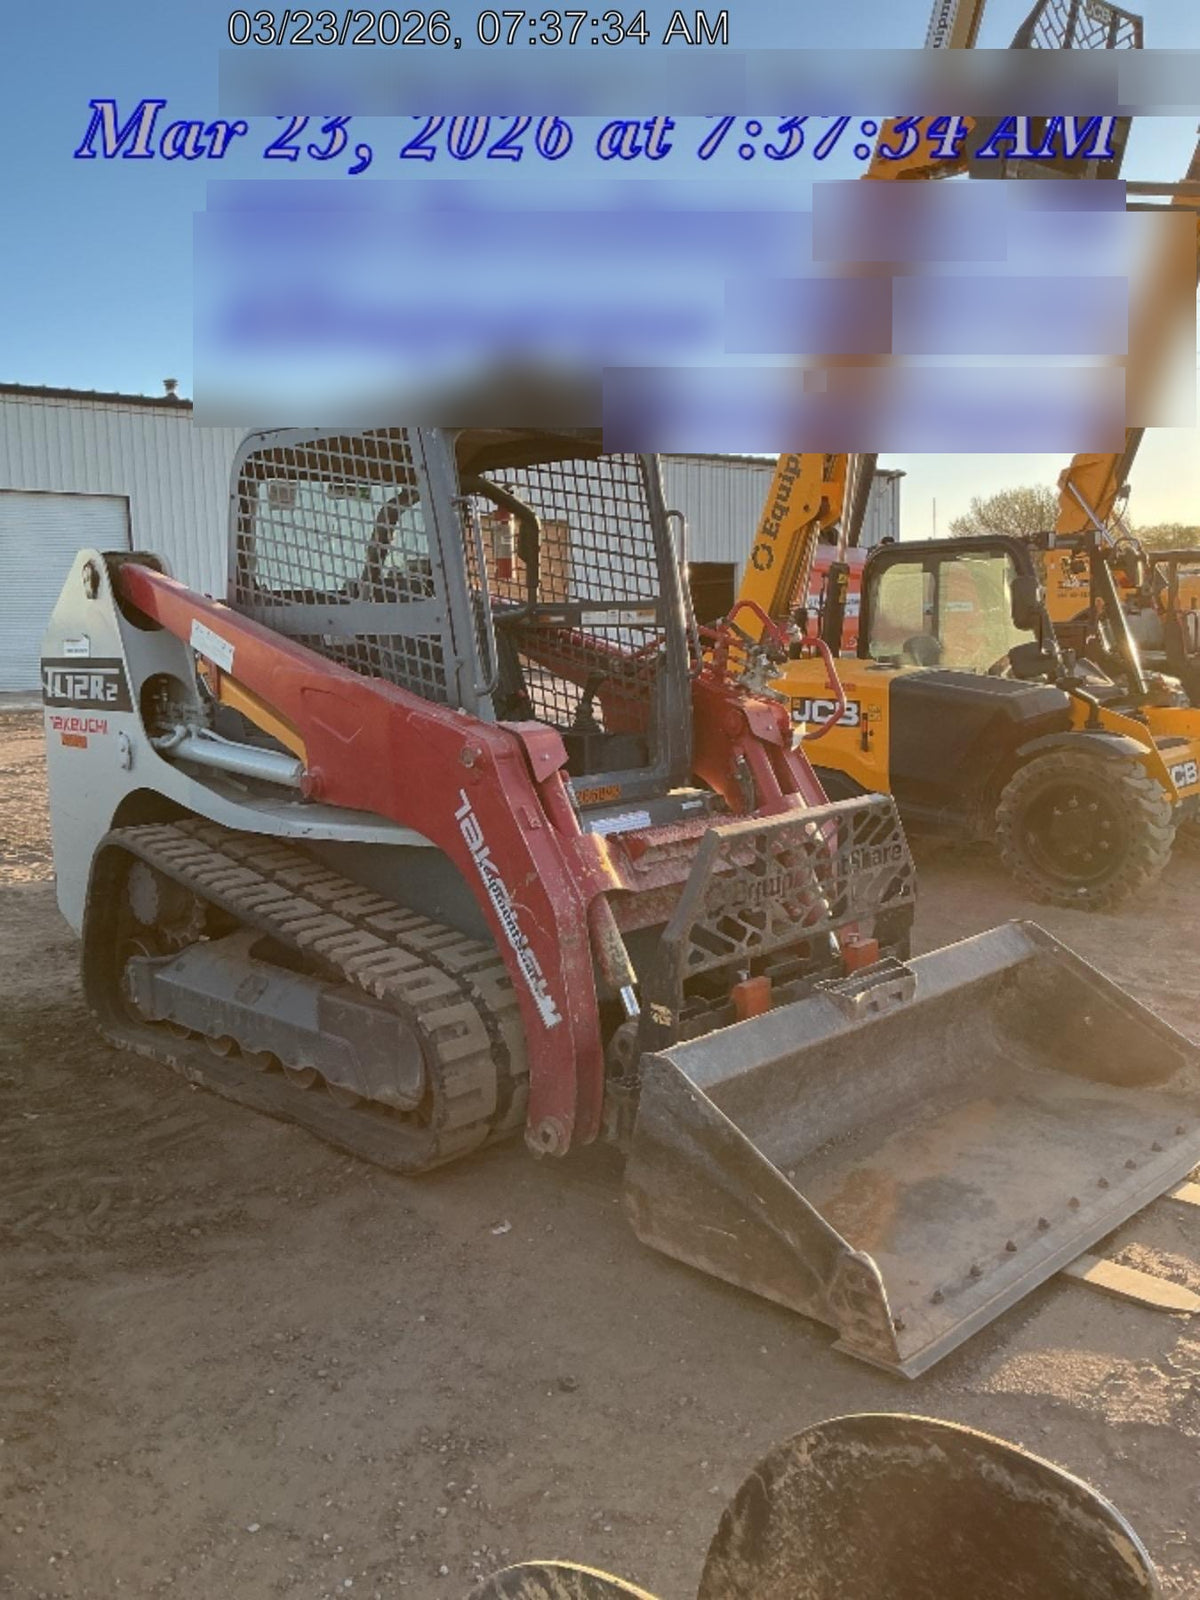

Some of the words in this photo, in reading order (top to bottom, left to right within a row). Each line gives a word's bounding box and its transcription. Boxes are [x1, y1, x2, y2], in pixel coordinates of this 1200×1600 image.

[761, 454, 802, 541] Equip
[792, 699, 860, 726] JCB
[1170, 761, 1197, 788] CB
